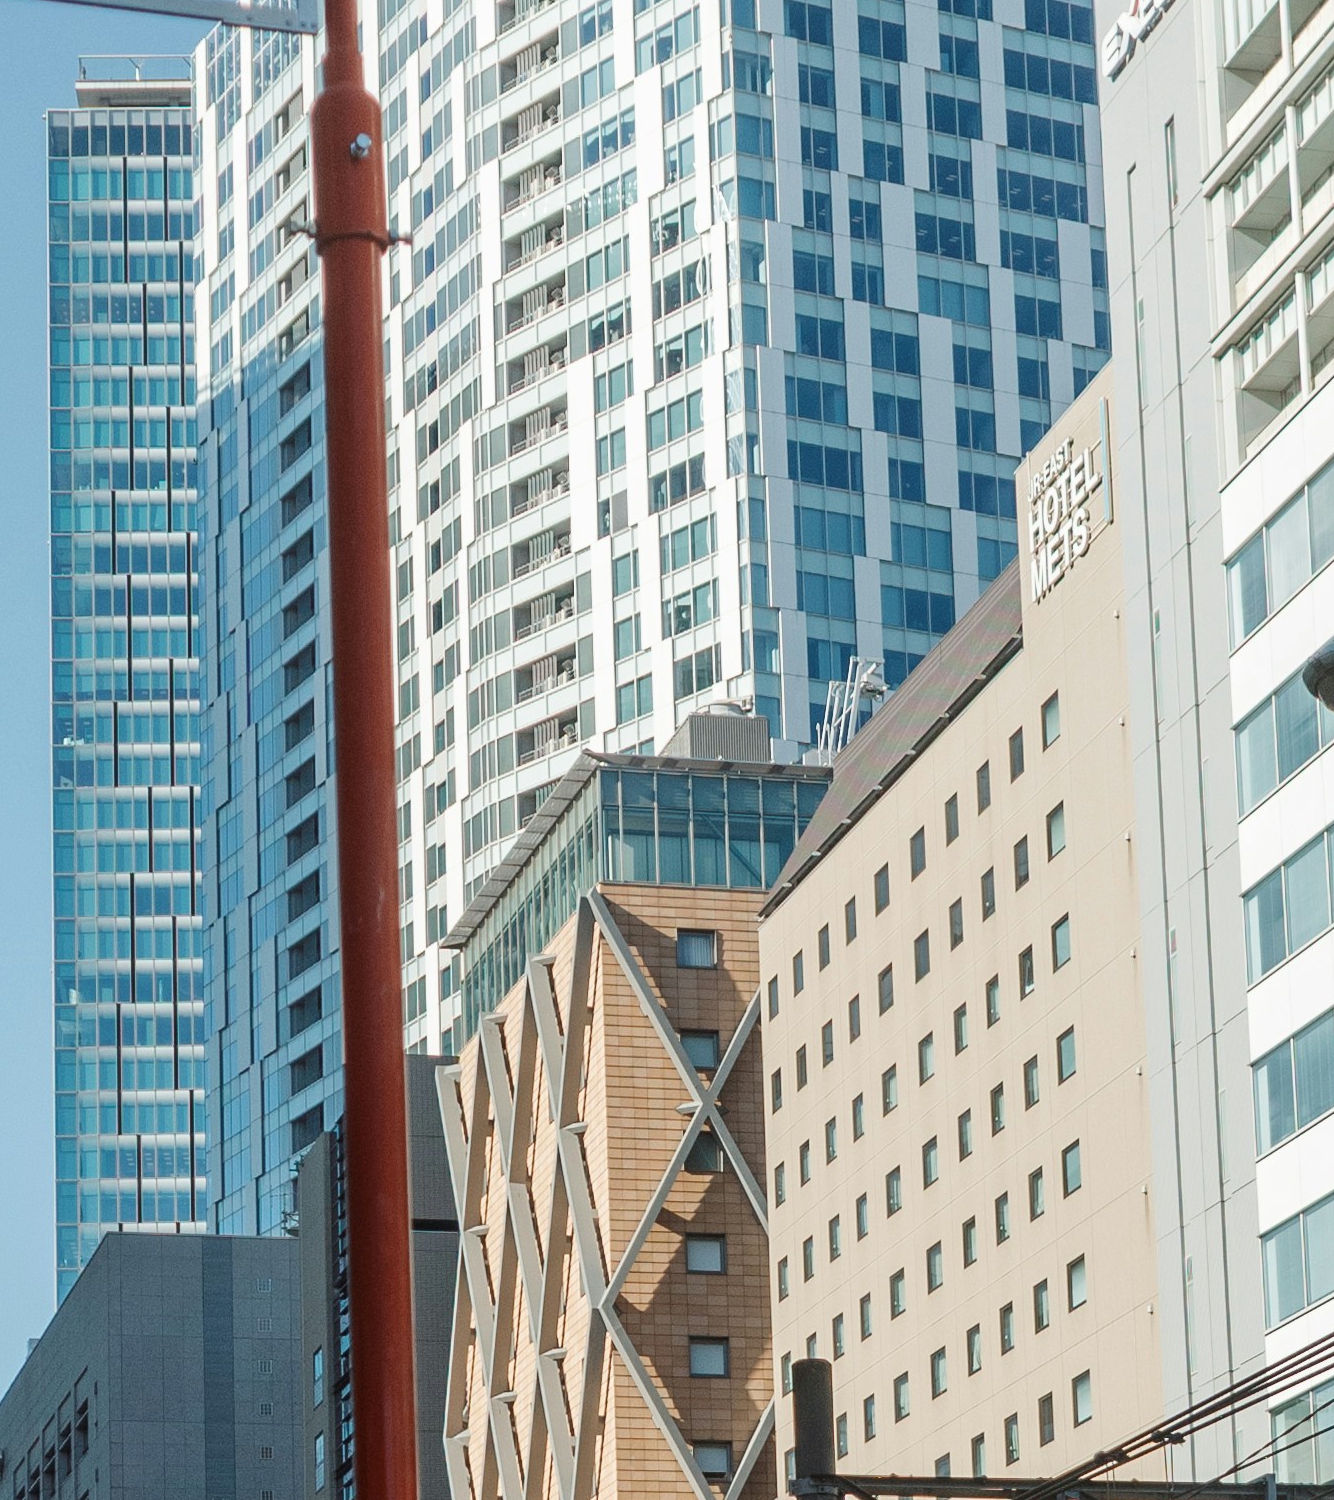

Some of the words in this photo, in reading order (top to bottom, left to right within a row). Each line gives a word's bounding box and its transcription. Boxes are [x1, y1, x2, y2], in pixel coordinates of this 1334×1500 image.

[1027, 436, 1074, 503] JR-EAST
[1028, 446, 1102, 554] HOTEL
[1030, 506, 1090, 604] METS
